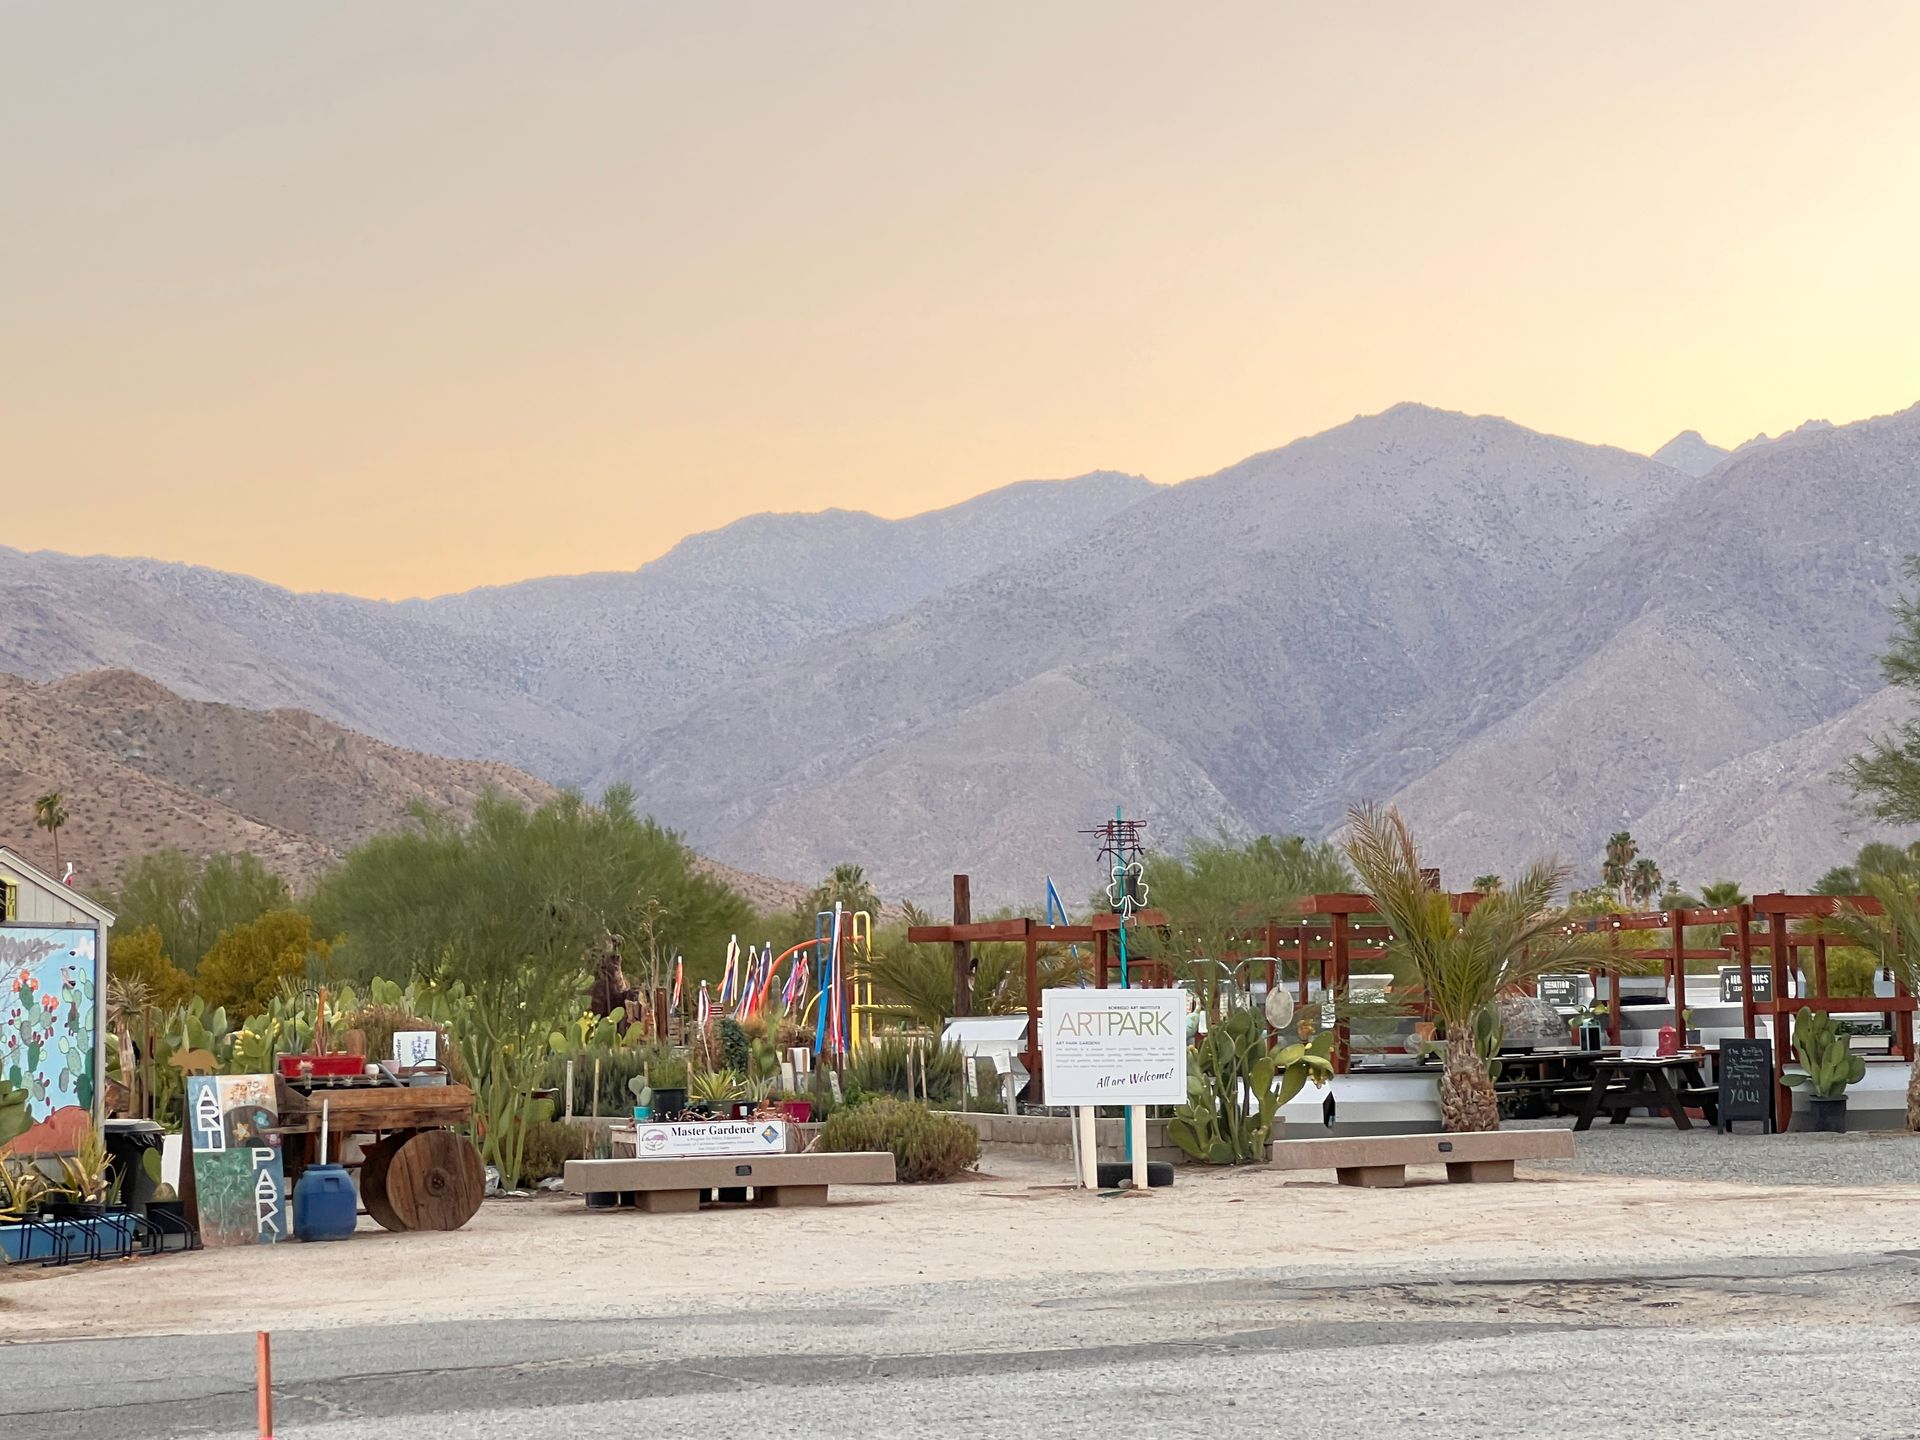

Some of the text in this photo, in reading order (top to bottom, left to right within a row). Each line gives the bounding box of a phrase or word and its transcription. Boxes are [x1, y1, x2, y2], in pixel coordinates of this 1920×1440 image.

[1730, 974, 1769, 985] AQUNICS
[1056, 1011, 1174, 1037] ARTPARK
[1096, 1067, 1174, 1089] All are Welcome!
[671, 1125, 757, 1137] Master Gardener
[251, 1147, 280, 1234] PARK
